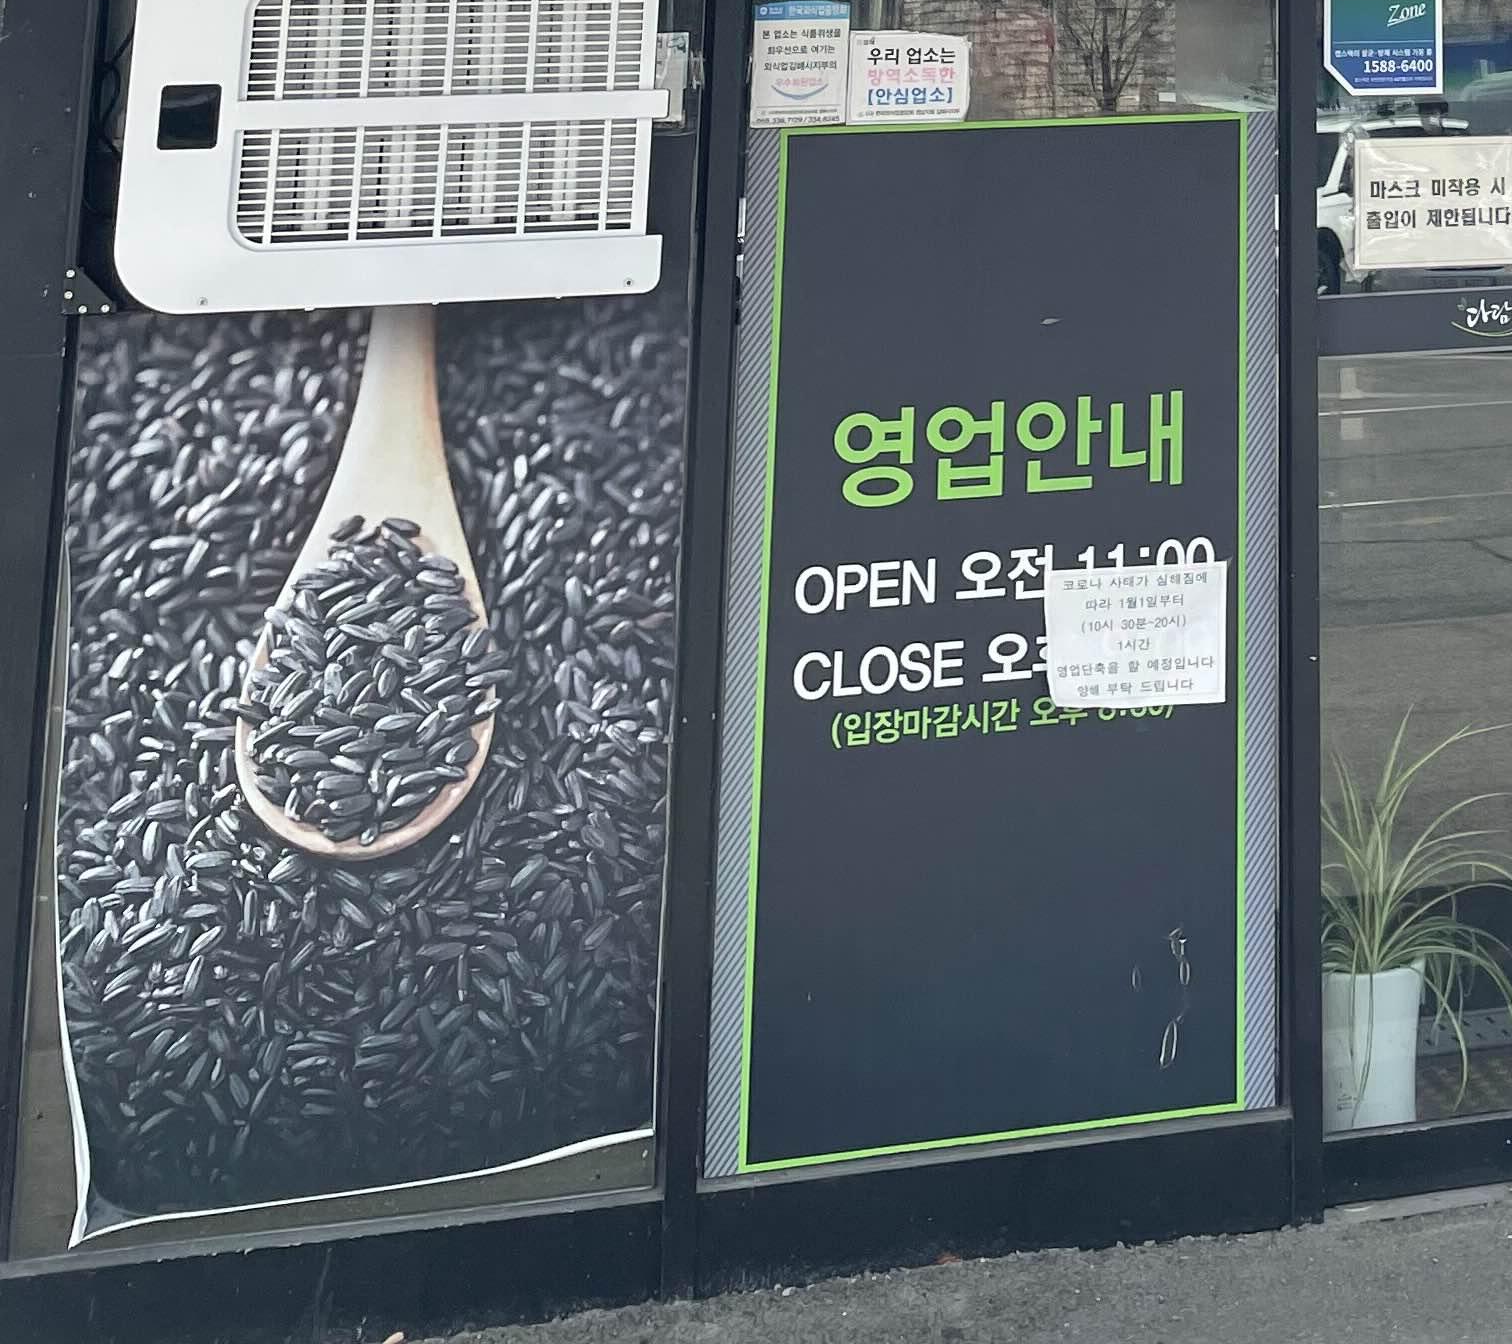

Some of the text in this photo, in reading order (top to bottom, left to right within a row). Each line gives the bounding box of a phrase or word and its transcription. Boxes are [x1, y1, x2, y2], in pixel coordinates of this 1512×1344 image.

[1387, 2, 1427, 28] Zone
[867, 47, 956, 65] 우리 업소는
[1363, 59, 1433, 73] 1588-6400
[867, 67, 956, 86] 방역소독한
[1370, 180, 1421, 199] 마스크
[1490, 177, 1506, 196] 시
[1366, 210, 1417, 230] 출입이
[833, 390, 1183, 508] 영업안내
[795, 558, 936, 614] OPEN
[956, 544, 1053, 600] 오전
[1063, 579, 1102, 591] 코로나
[1110, 576, 1149, 589] 사태가
[1086, 594, 1184, 611] 따라 1월1일부터
[1081, 620, 1113, 633] (10시
[1118, 638, 1150, 651] 1시간
[793, 639, 965, 701] CLOSE
[1057, 655, 1214, 678] 영업단축을 할 예정입니다
[1077, 678, 1194, 697] 양해 부탁 드립니다
[831, 698, 1021, 749] (입장마감시간
